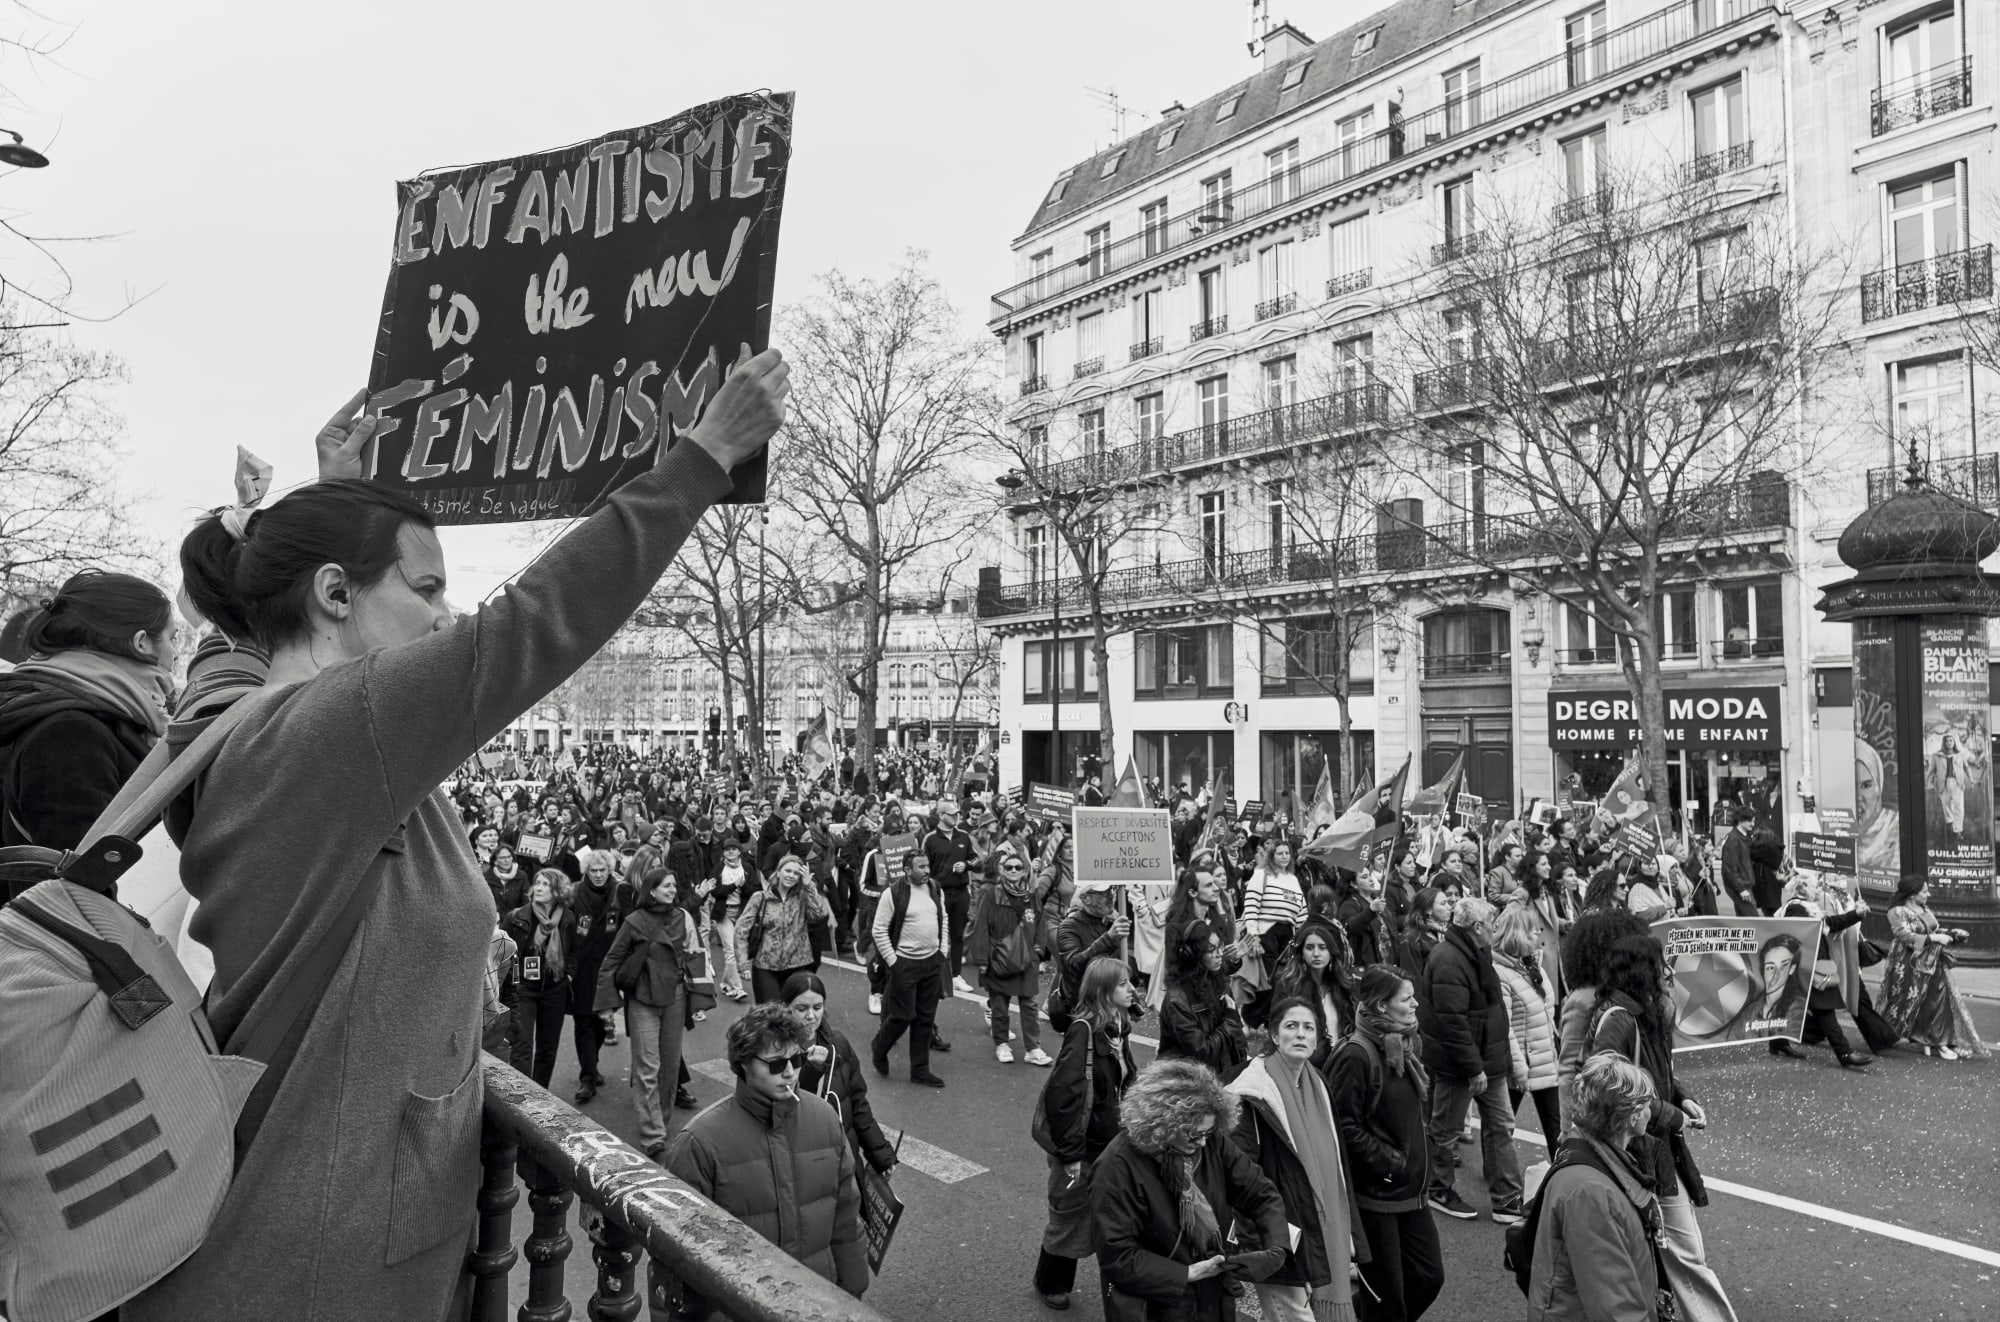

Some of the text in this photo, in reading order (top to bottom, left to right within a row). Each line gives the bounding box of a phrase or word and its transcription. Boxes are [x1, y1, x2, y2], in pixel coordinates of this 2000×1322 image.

[428, 217, 751, 350] is the new
[1924, 647, 1957, 657] DANS
[1924, 656, 1988, 672] BLANC
[1670, 697, 1768, 720] MODA
[1557, 729, 1615, 741] HOMME
[1700, 728, 1769, 741] ENFANT
[1079, 816, 1168, 828] RESPECT DIVERSITÉ
[1101, 831, 1155, 842] ACCEPTONS
[1119, 846, 1139, 857] NOS
[1930, 868, 1944, 876] AU
[1730, 929, 1740, 938] ME
